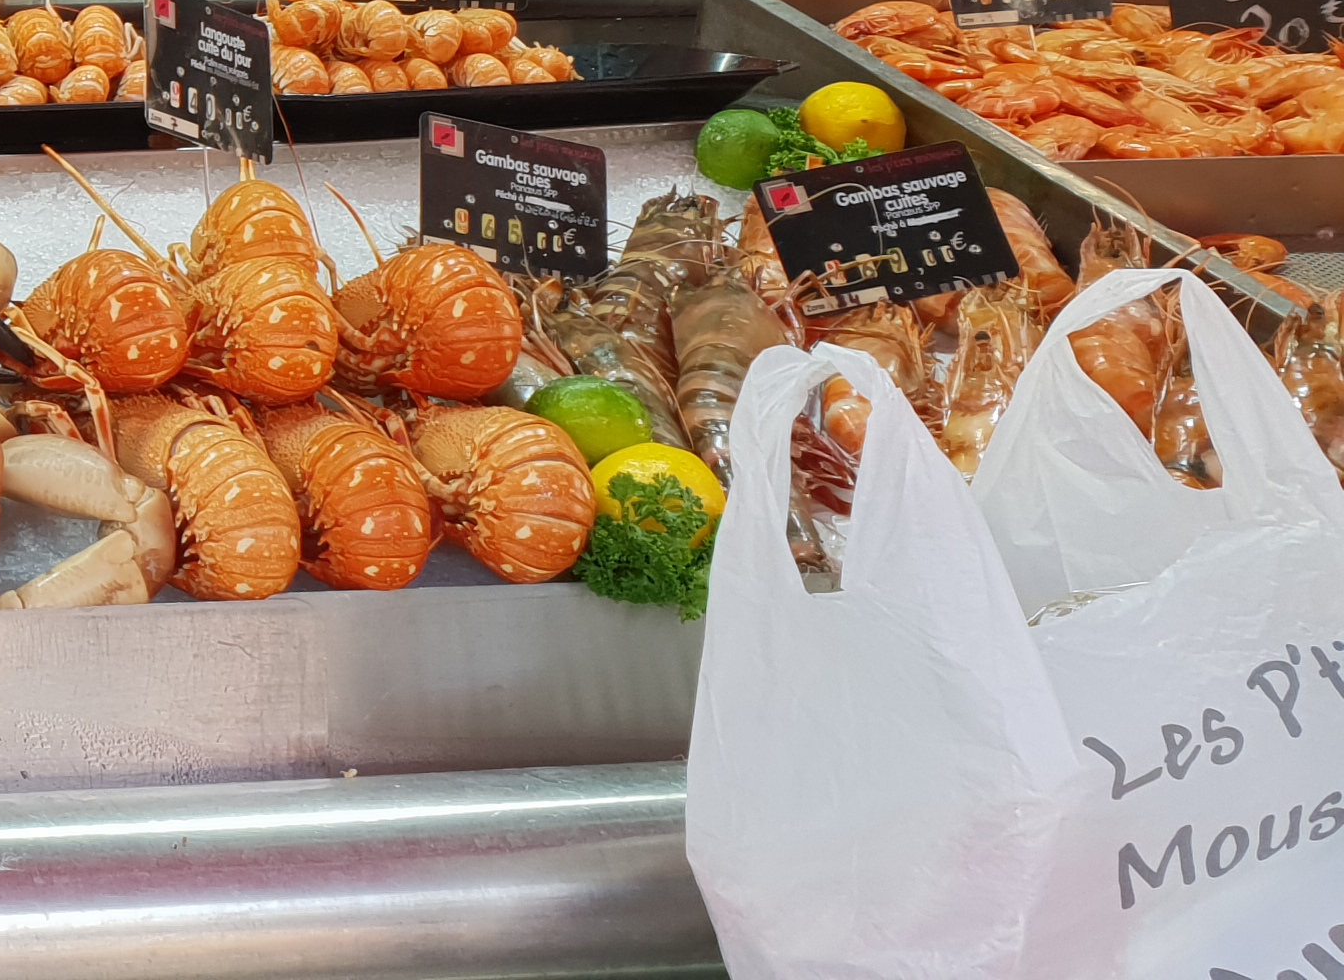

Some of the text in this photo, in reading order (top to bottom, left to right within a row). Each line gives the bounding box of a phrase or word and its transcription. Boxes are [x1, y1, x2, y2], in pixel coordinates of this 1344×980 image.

[200, 22, 246, 52] Langouste
[475, 149, 587, 187] Gambas sauvage
[516, 172, 551, 189] crues
[835, 170, 967, 207] Gambas sauvage
[885, 193, 930, 211] cuites
[1082, 707, 1244, 801] Les
